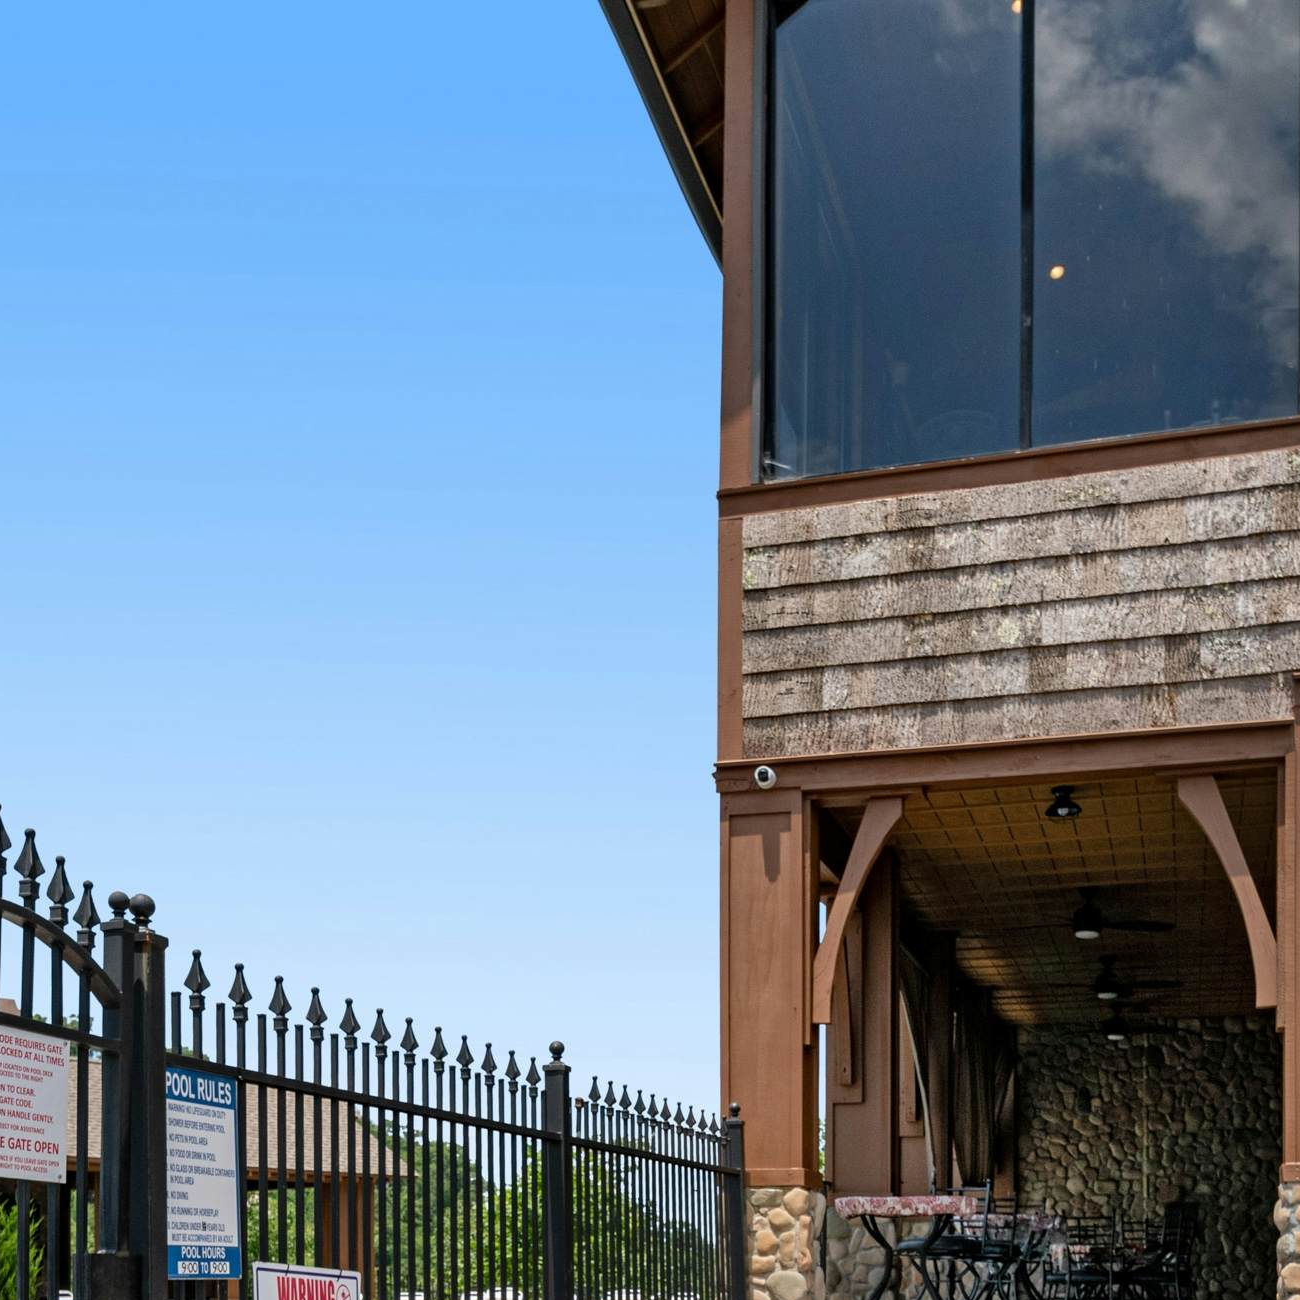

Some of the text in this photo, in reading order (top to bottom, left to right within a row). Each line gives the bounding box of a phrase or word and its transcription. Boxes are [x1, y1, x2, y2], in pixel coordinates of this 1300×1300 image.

[15, 1037, 46, 1051] REQUIRES
[47, 1044, 63, 1055] GATE
[24, 1051, 32, 1060] AT
[34, 1053, 44, 1063] ALL
[46, 1055, 65, 1067] TIMES
[3, 1062, 22, 1071] LOCATED
[31, 1067, 42, 1075] POOL
[7, 1084, 15, 1093] TO
[166, 1071, 232, 1105] POOL RULES
[0, 1096, 14, 1105] GATE
[7, 1109, 30, 1120] HANDLE
[20, 1125, 45, 1135] ASSISTANCE
[185, 1120, 198, 1129] BEFORE
[8, 1137, 32, 1152] GATE
[34, 1140, 60, 1155] OPEN
[170, 1164, 175, 1172] NO
[176, 1164, 187, 1173] GLASS
[188, 1165, 193, 1174] OR
[194, 1166, 214, 1176] BREAKABLE
[171, 1191, 176, 1199] NO
[181, 1246, 226, 1259] POOL HOURS
[201, 1262, 209, 1274] TO
